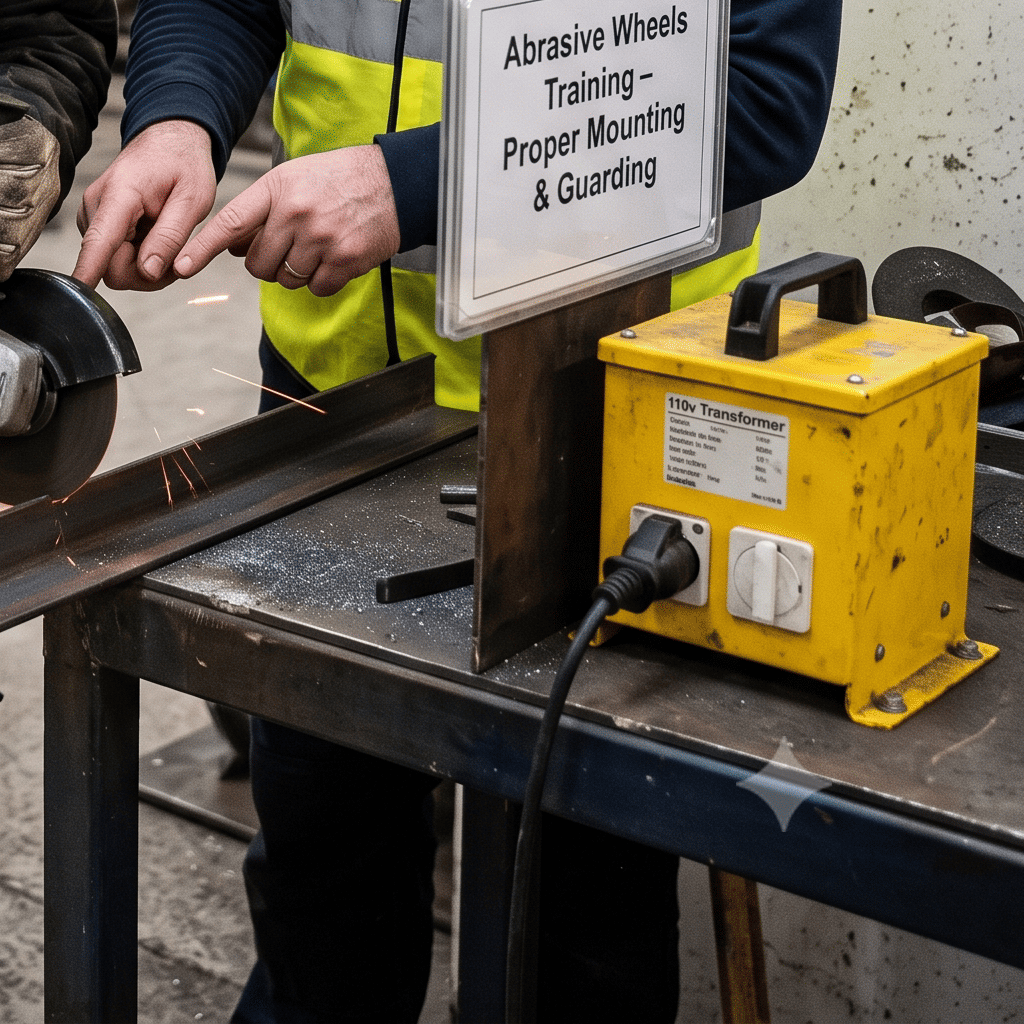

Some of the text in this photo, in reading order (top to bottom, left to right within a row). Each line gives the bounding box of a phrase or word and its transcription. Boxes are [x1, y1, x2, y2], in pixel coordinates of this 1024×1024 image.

[503, 5, 688, 70] Abrasive Wheels
[544, 66, 634, 110] Training
[503, 101, 685, 171] Proper Mounting
[533, 156, 657, 212] & Guarding
[668, 396, 696, 414] 110v
[700, 402, 786, 433] Transformer
